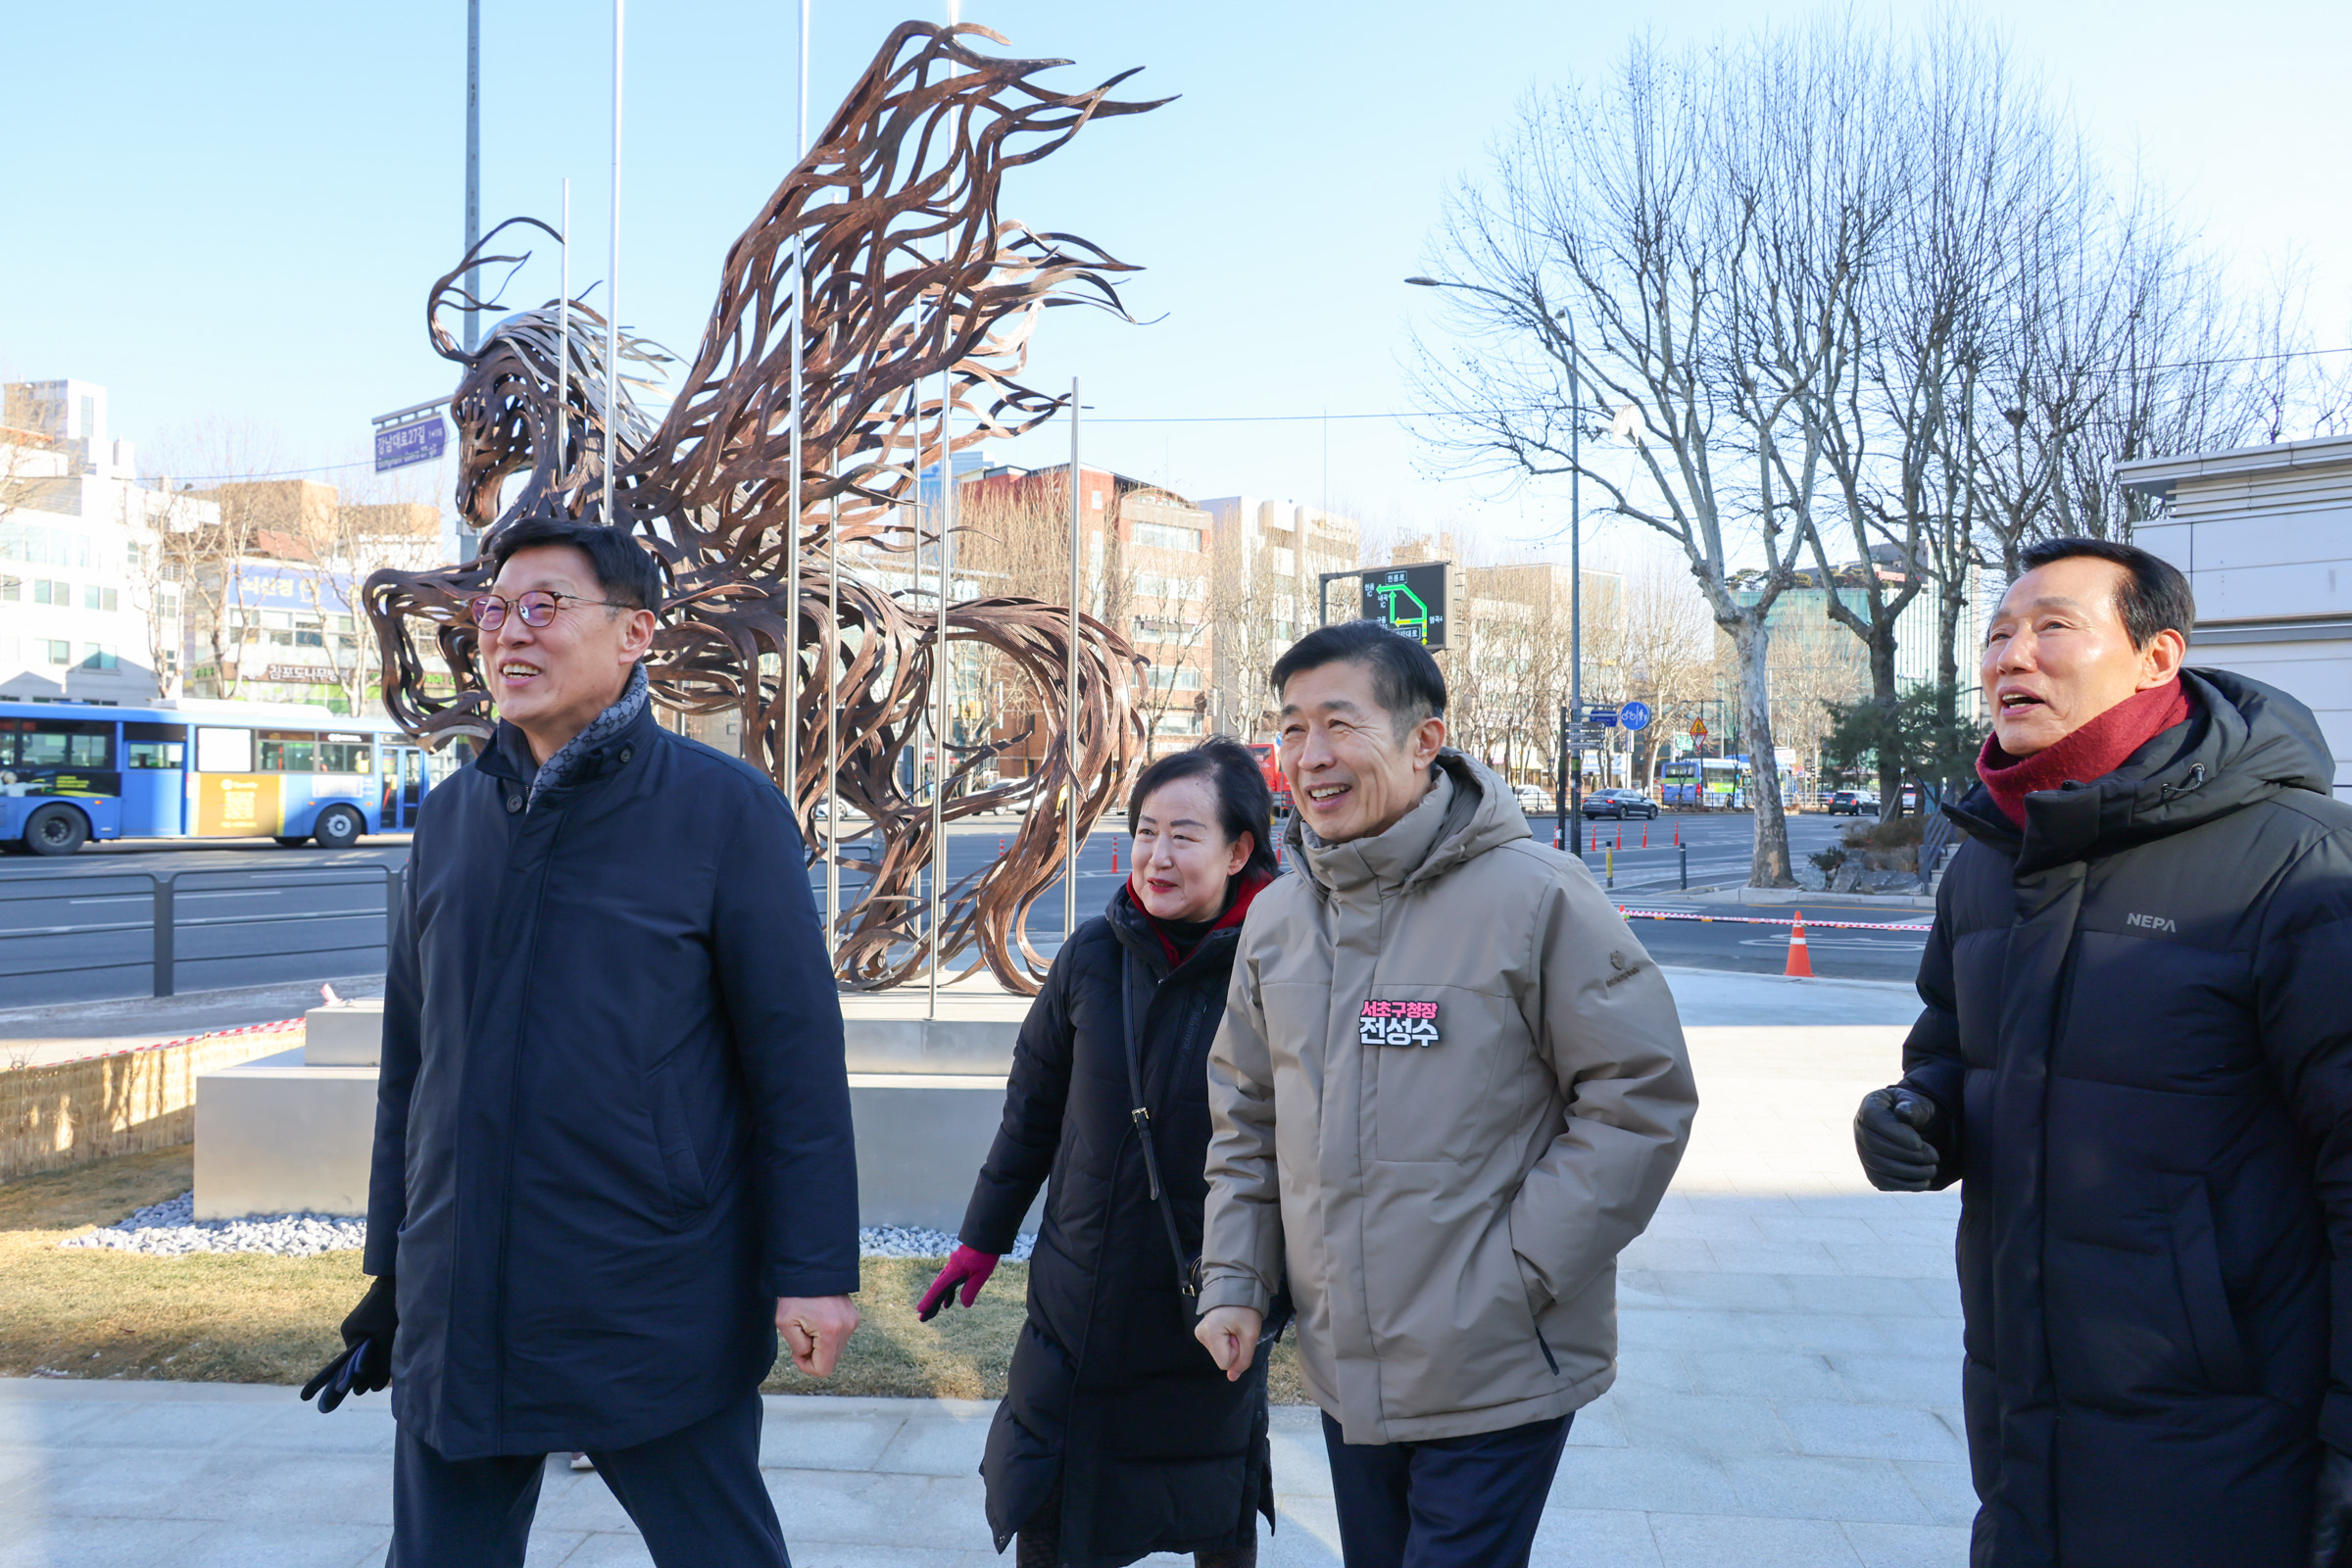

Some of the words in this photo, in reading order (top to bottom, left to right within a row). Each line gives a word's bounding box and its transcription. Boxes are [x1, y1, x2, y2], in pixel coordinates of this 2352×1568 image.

[377, 424, 425, 456] 강남대로27길
[242, 576, 294, 597] 뇌신경
[2127, 912, 2177, 933] NEPA
[1361, 1001, 1438, 1019] 서초구청장
[1359, 1016, 1439, 1047] 전성수
